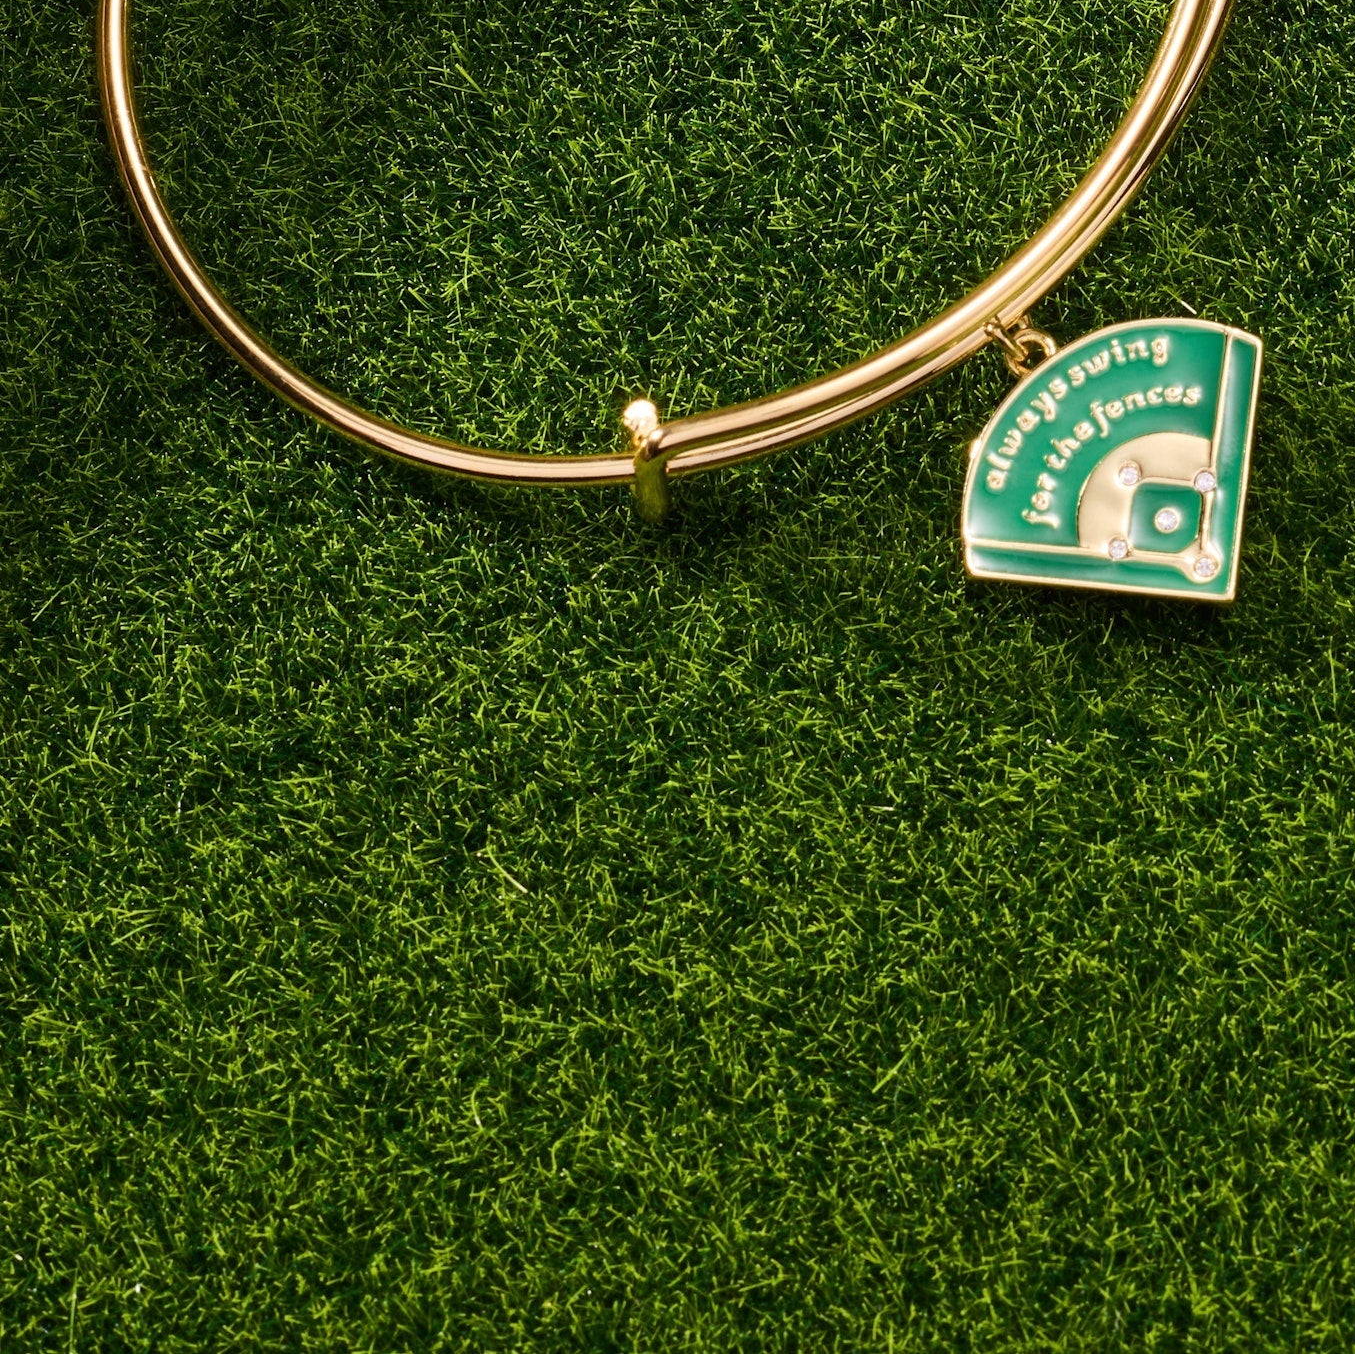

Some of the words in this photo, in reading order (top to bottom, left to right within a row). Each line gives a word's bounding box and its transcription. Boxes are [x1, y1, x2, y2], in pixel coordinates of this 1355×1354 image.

[987, 377, 1068, 490] always
[1067, 337, 1169, 386] swing
[1022, 472, 1060, 529] for
[1044, 418, 1096, 470] the
[1089, 383, 1202, 438] fences
